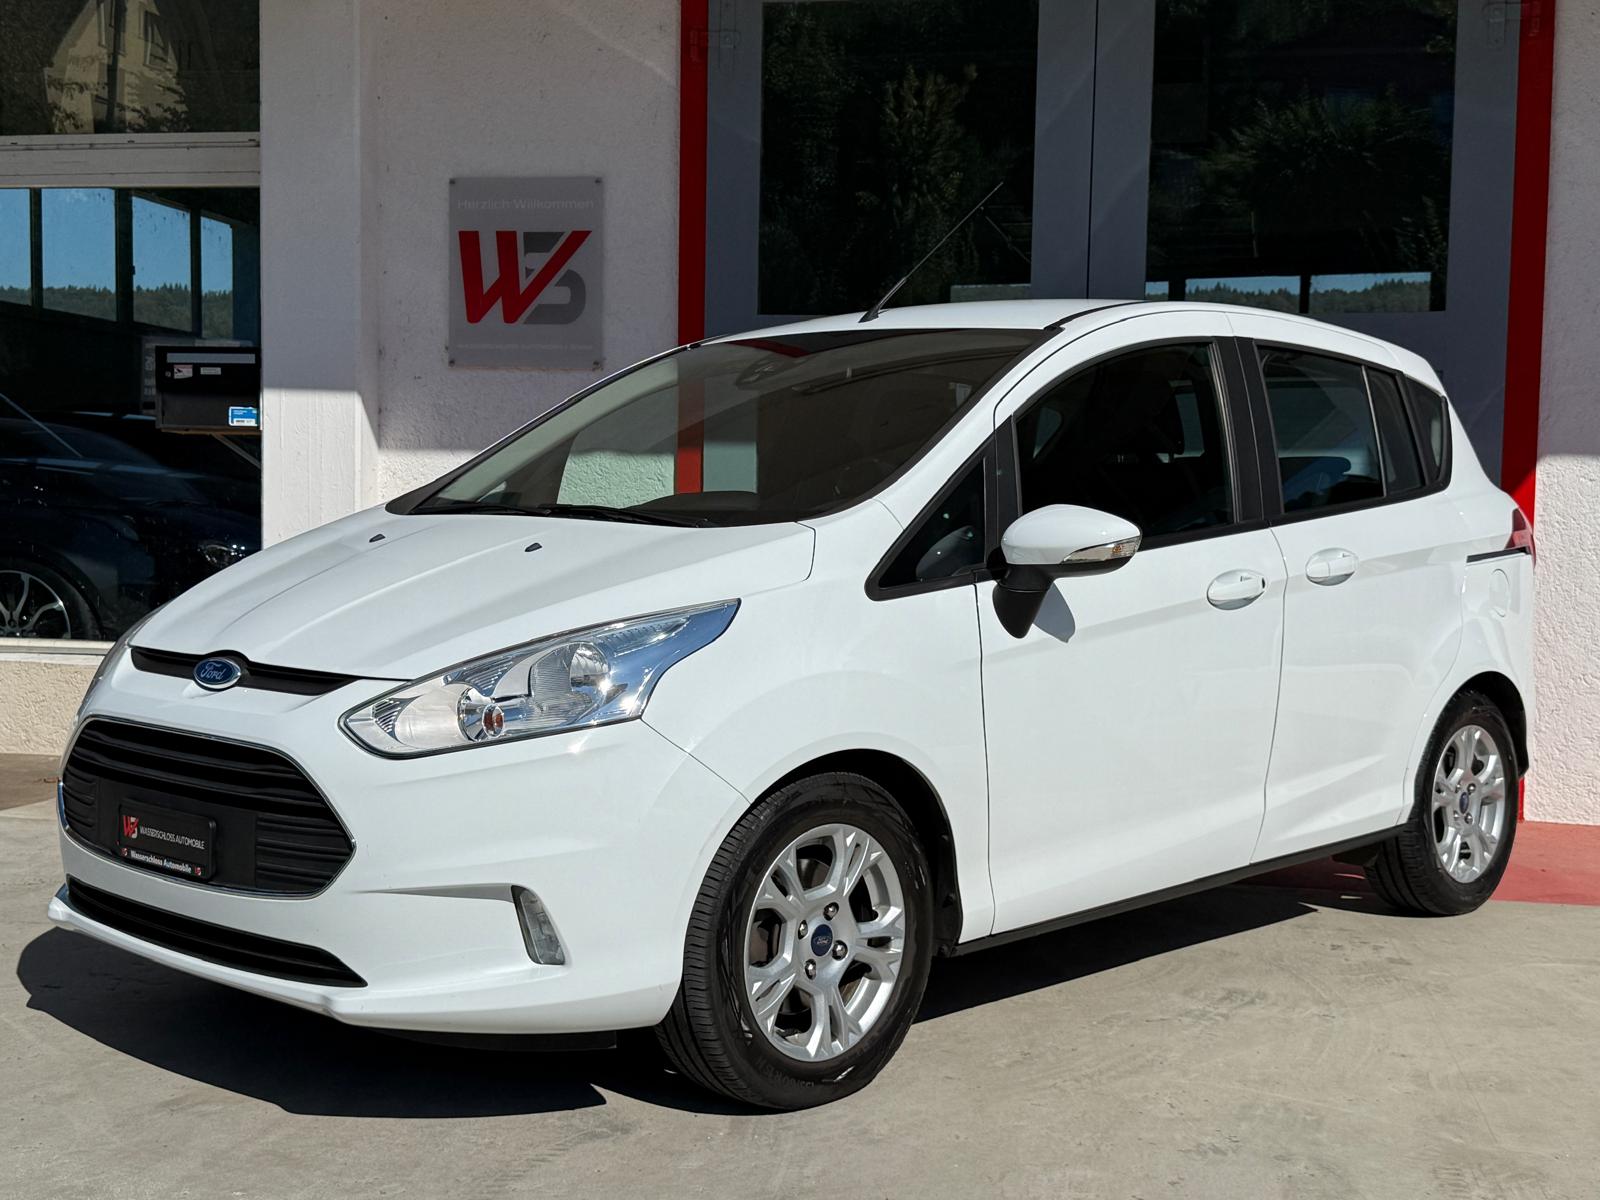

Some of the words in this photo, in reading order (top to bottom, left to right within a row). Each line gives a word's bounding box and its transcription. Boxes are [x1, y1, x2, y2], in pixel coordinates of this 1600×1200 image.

[457, 199, 512, 209] Herzlich
[513, 199, 594, 209] Willkommen
[200, 662, 226, 681] Ford
[140, 826, 176, 842] WASSERSCHLOSS
[176, 835, 205, 850] AUTOMOBILE
[130, 850, 162, 866] Wasserschloss
[163, 859, 192, 874] Automobile
